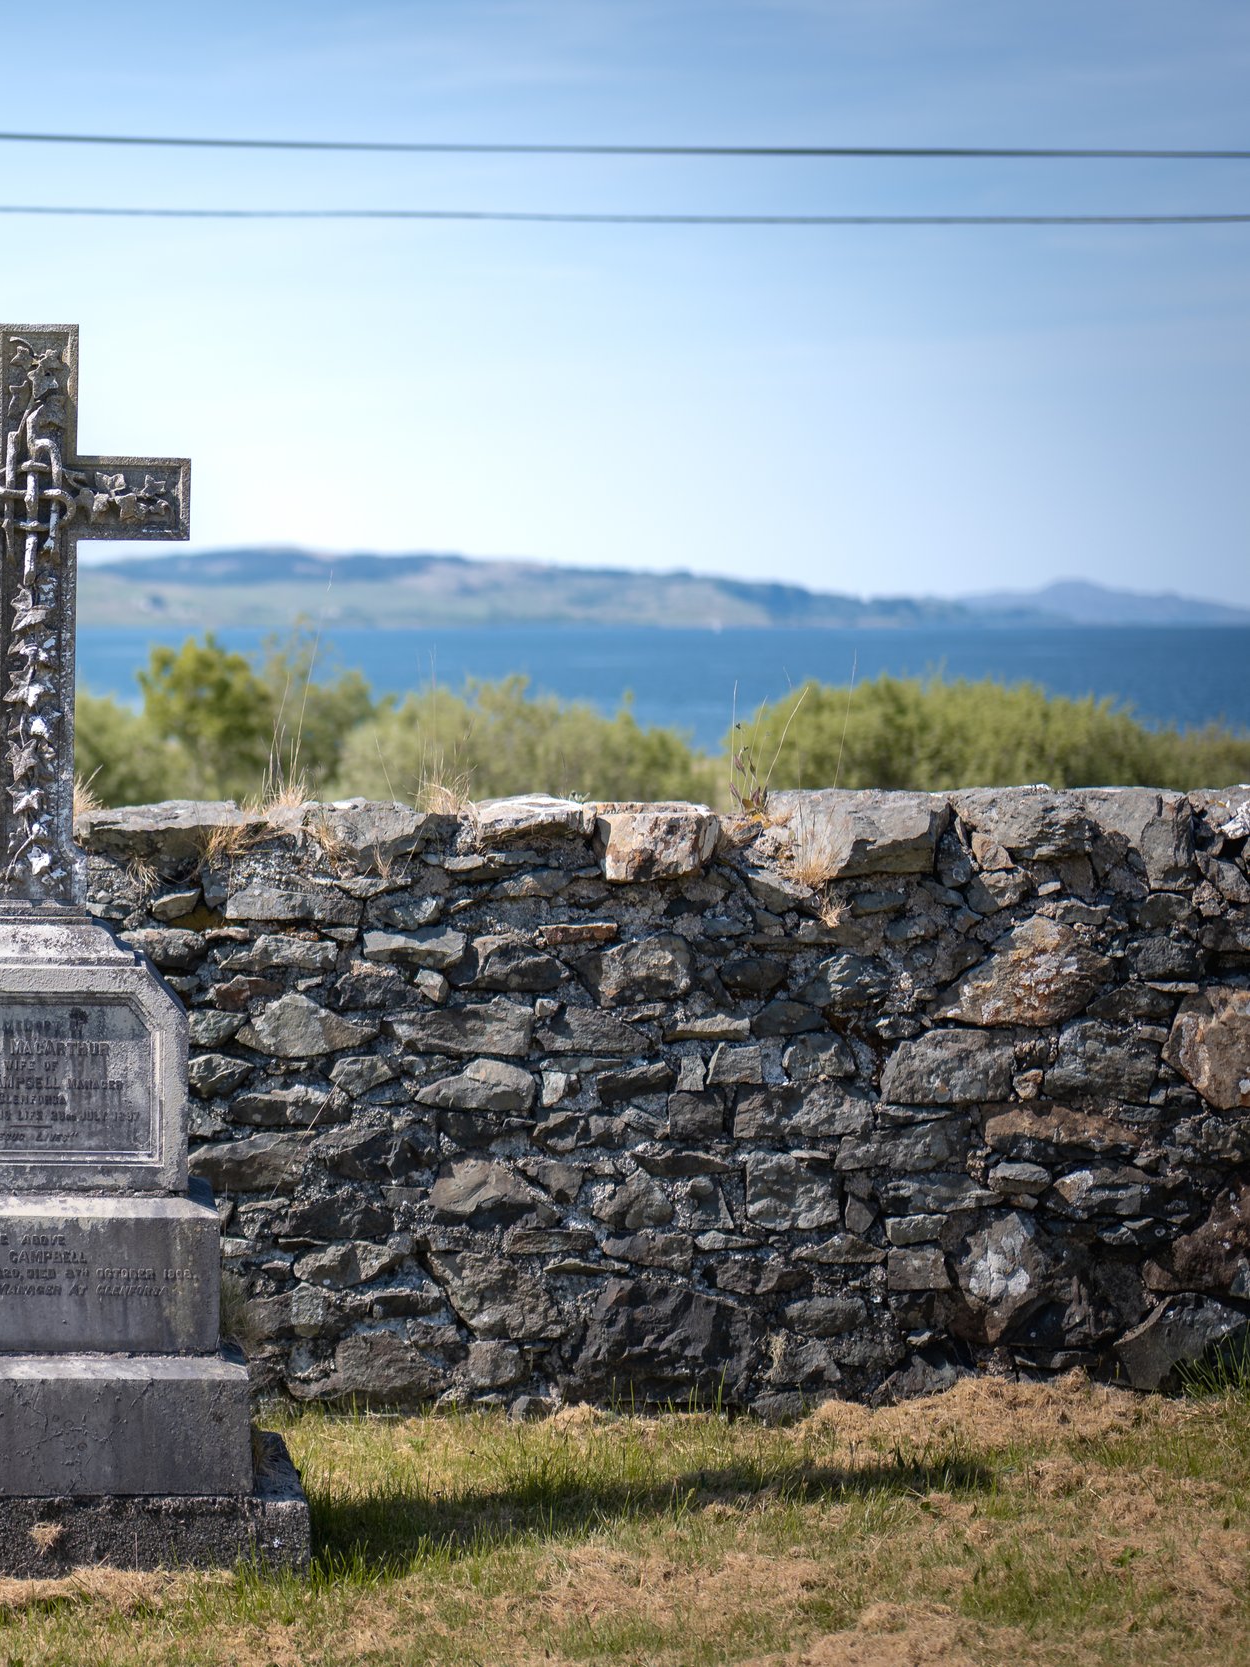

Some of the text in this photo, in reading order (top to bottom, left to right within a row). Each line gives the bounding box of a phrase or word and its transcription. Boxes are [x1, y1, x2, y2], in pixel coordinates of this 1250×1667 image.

[4, 1060, 59, 1071] WIFE OF
[67, 1079, 123, 1090] MANAGER
[18, 1110, 43, 1121] LIFE
[80, 1111, 108, 1121] JULY
[20, 1234, 67, 1246] ABOVE
[8, 1249, 88, 1264] CAMPBELL
[26, 1268, 57, 1280] DIED
[96, 1268, 157, 1280] OCTOBER
[68, 1283, 88, 1296] AT
